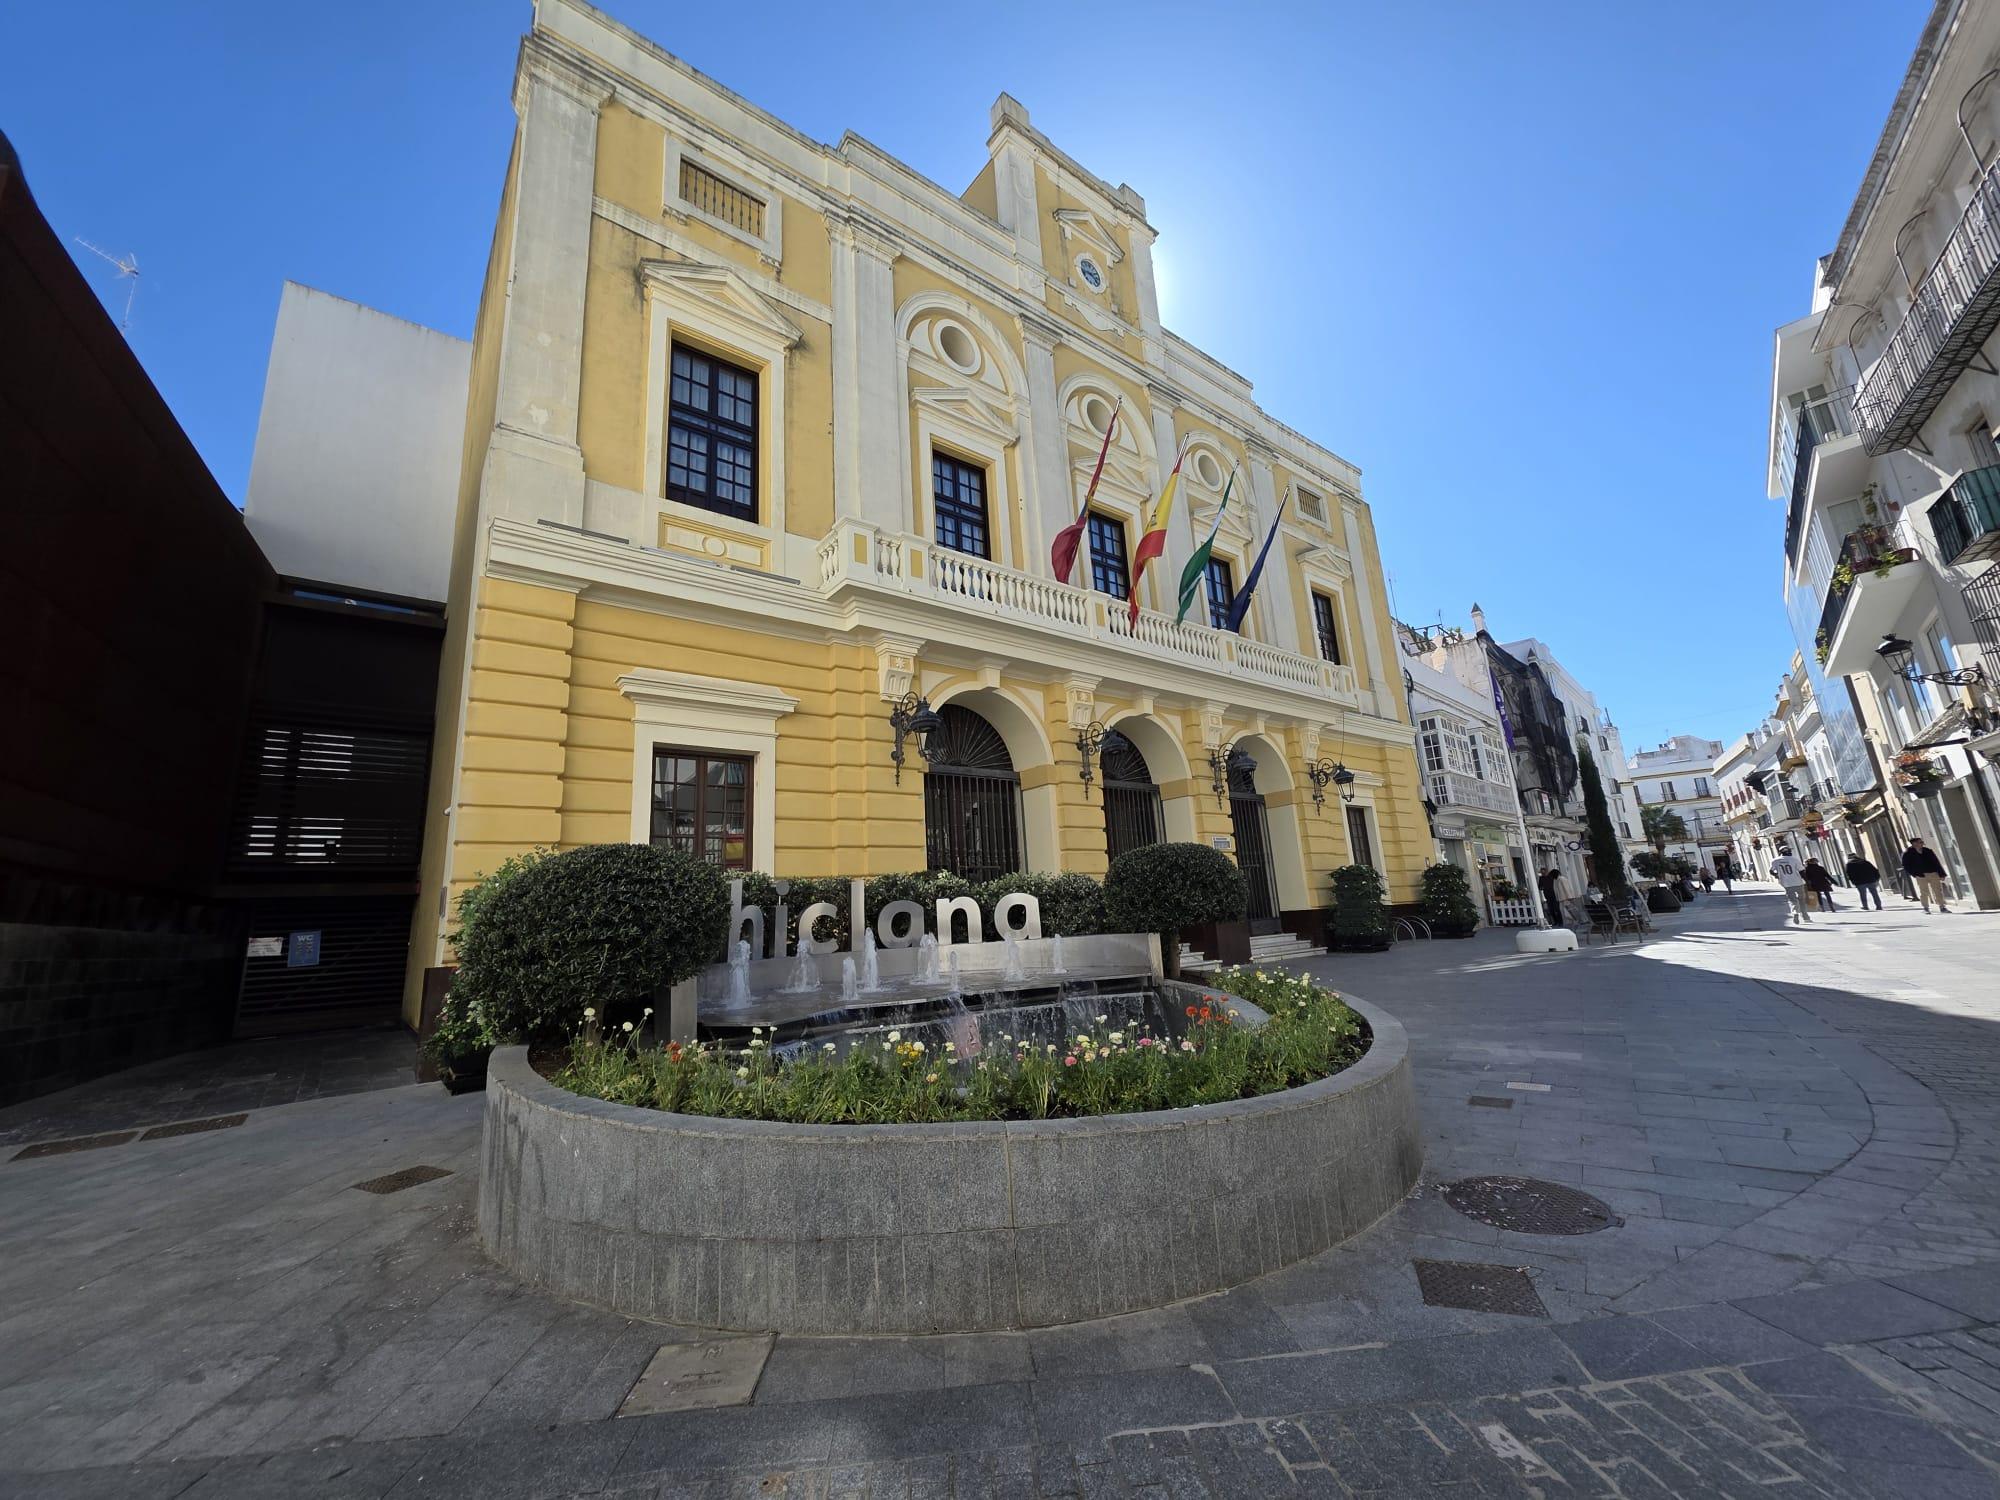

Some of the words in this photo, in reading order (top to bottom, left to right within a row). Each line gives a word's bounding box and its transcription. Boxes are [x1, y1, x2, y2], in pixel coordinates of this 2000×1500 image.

[1779, 864, 1792, 874] 10
[728, 879, 1042, 963] hiclana
[297, 934, 314, 942] WC
